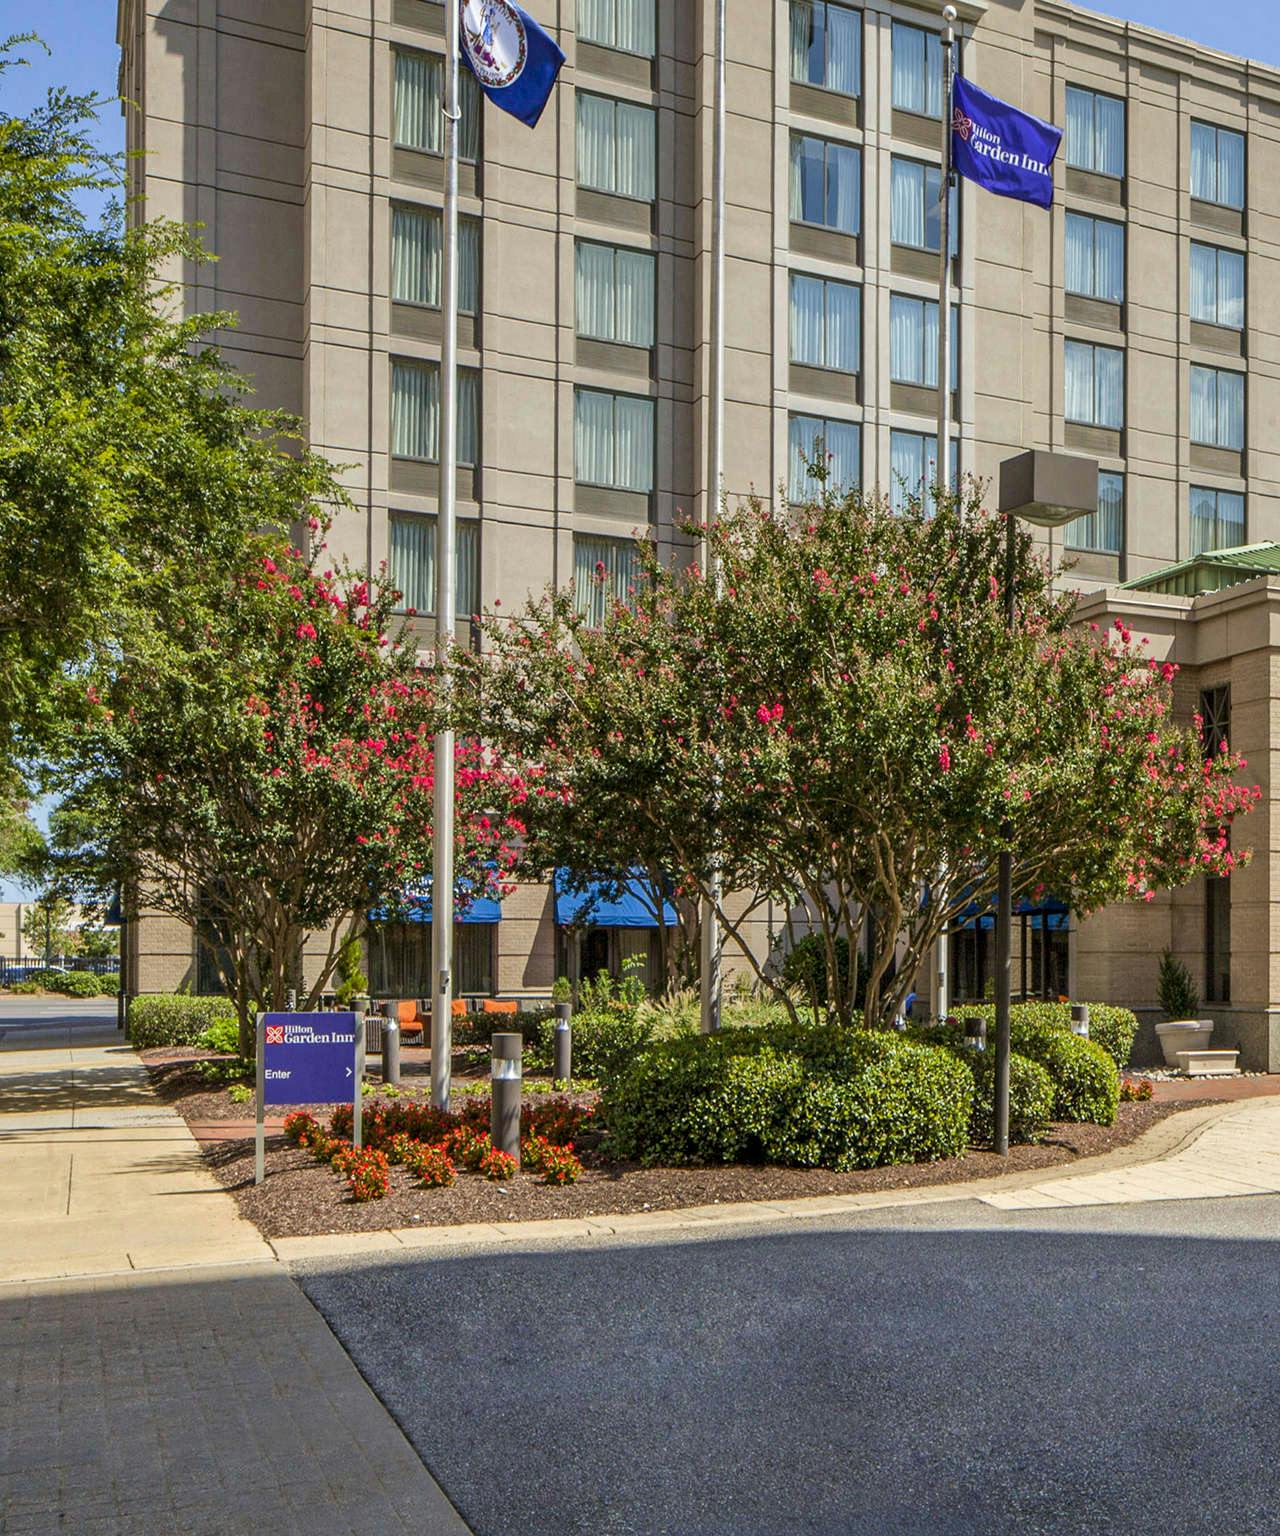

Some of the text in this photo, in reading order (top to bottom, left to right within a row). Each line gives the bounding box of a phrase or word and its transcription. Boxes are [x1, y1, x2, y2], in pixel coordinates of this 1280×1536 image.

[284, 1024, 313, 1033] Hilton
[284, 1031, 355, 1044] Garden Inn
[264, 1069, 292, 1080] Enter
